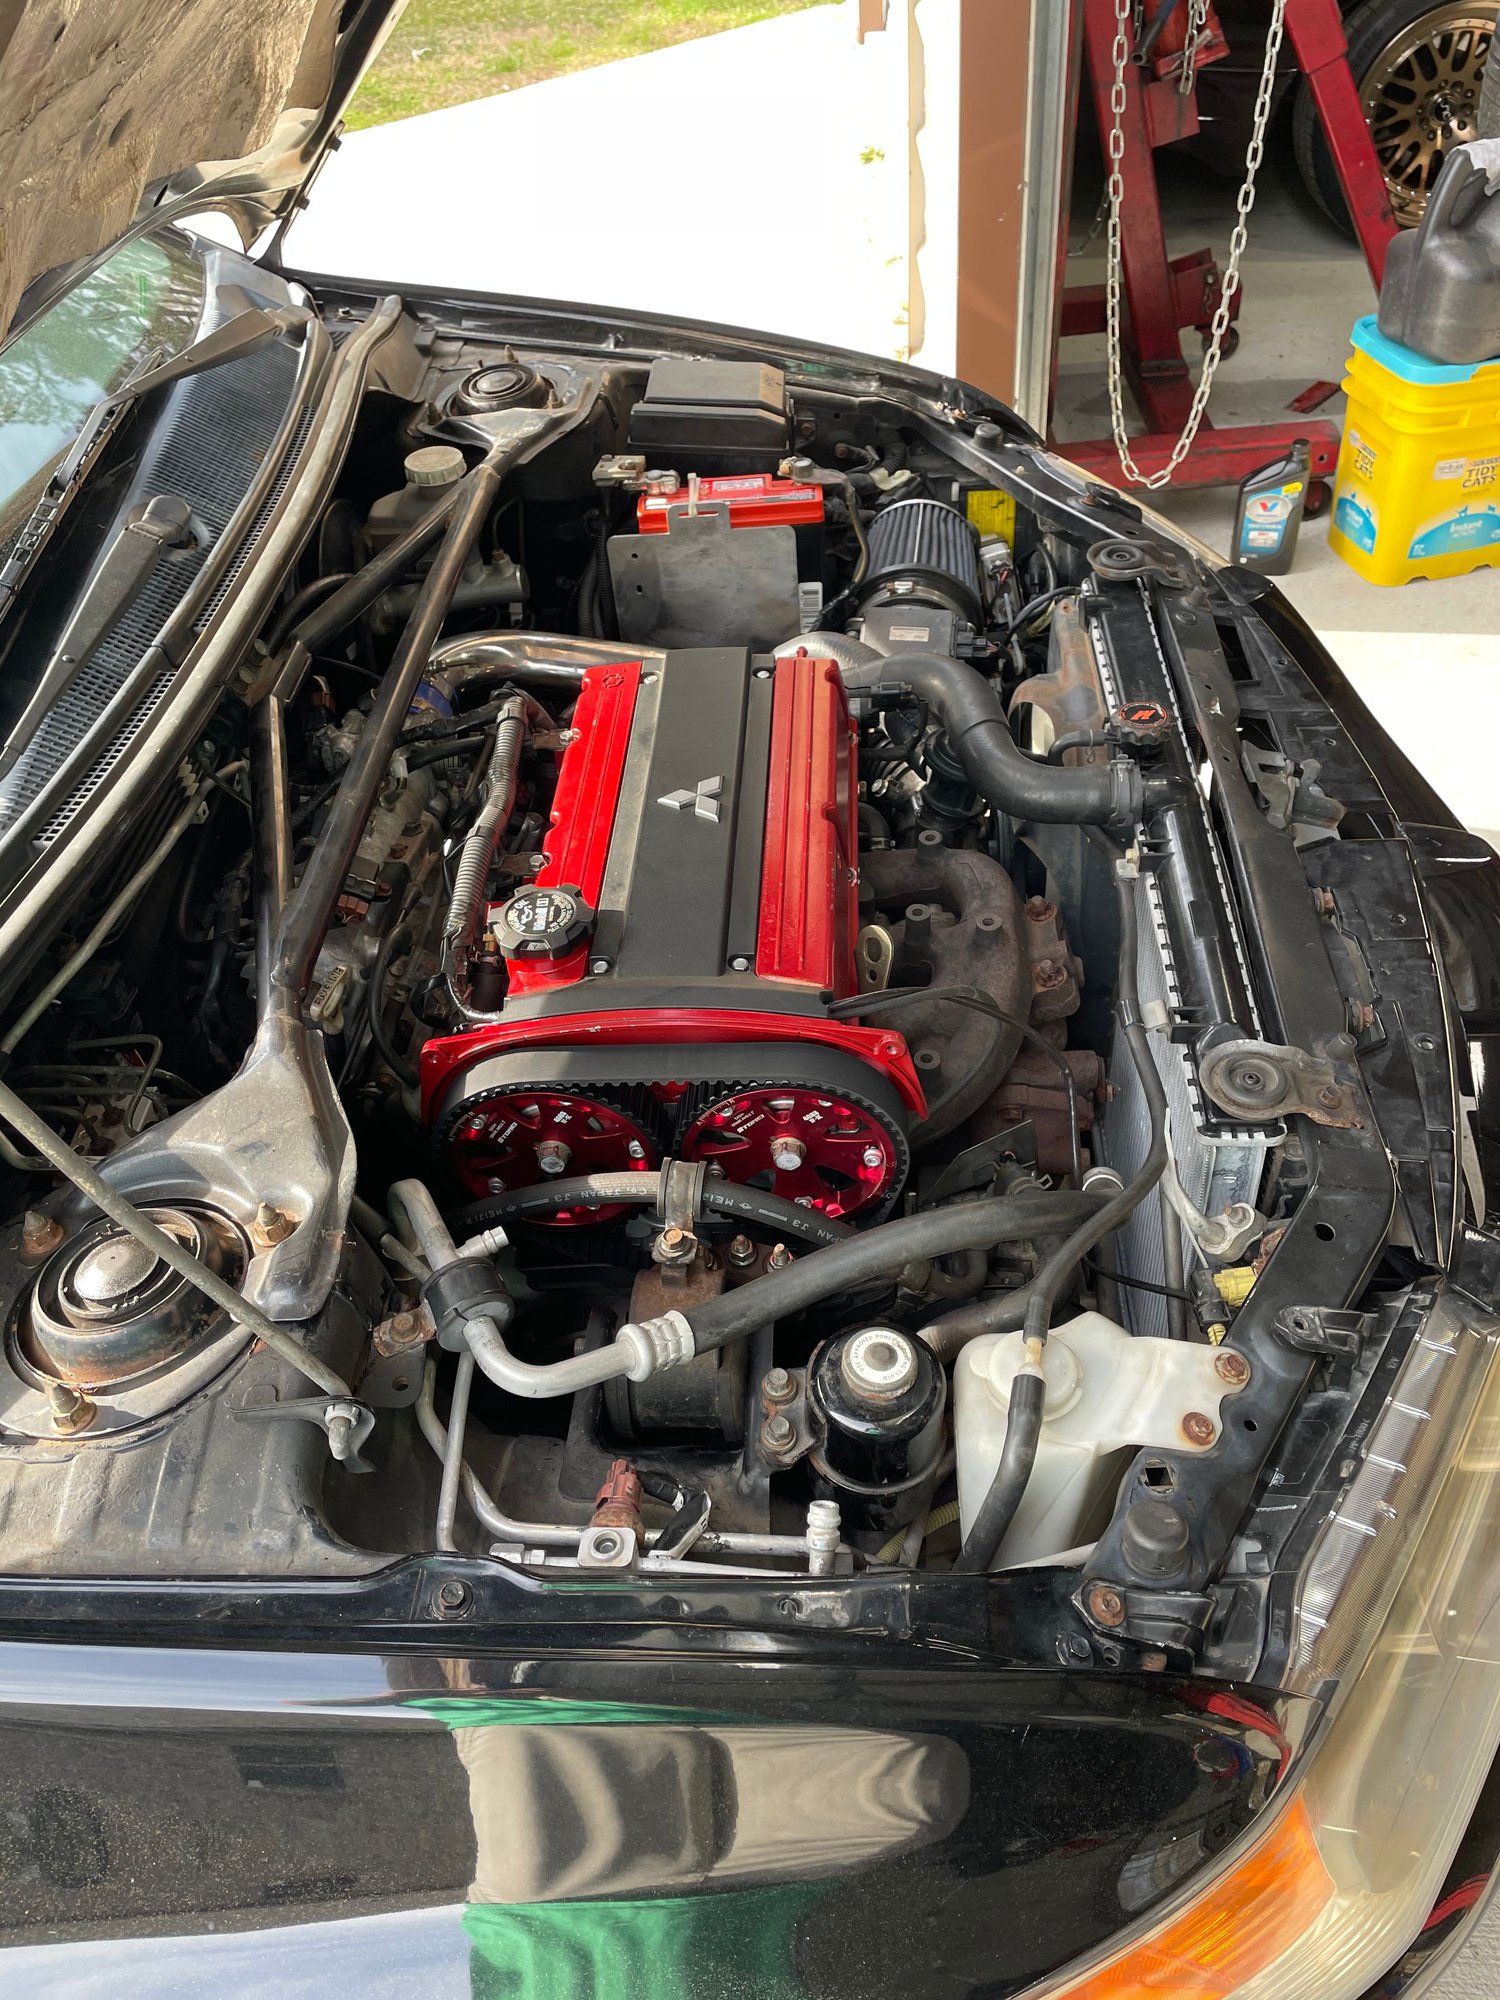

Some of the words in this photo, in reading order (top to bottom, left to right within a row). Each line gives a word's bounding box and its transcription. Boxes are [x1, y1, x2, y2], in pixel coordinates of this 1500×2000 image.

[1355, 450, 1375, 469] TIDY
[1354, 460, 1374, 480] CATS
[1466, 464, 1499, 479] TIDY
[1462, 474, 1497, 489] CATS
[514, 899, 530, 909] OIL
[507, 909, 526, 932] ENGINE
[313, 967, 344, 1005] ENGINE
[554, 1194, 571, 1202] J3
[580, 1188, 621, 1199] JAPAN
[474, 1207, 503, 1220] MEIJI
[854, 1335, 873, 1358] APPROVED
[855, 1361, 865, 1373] USE
[882, 1370, 903, 1381] FLUID
